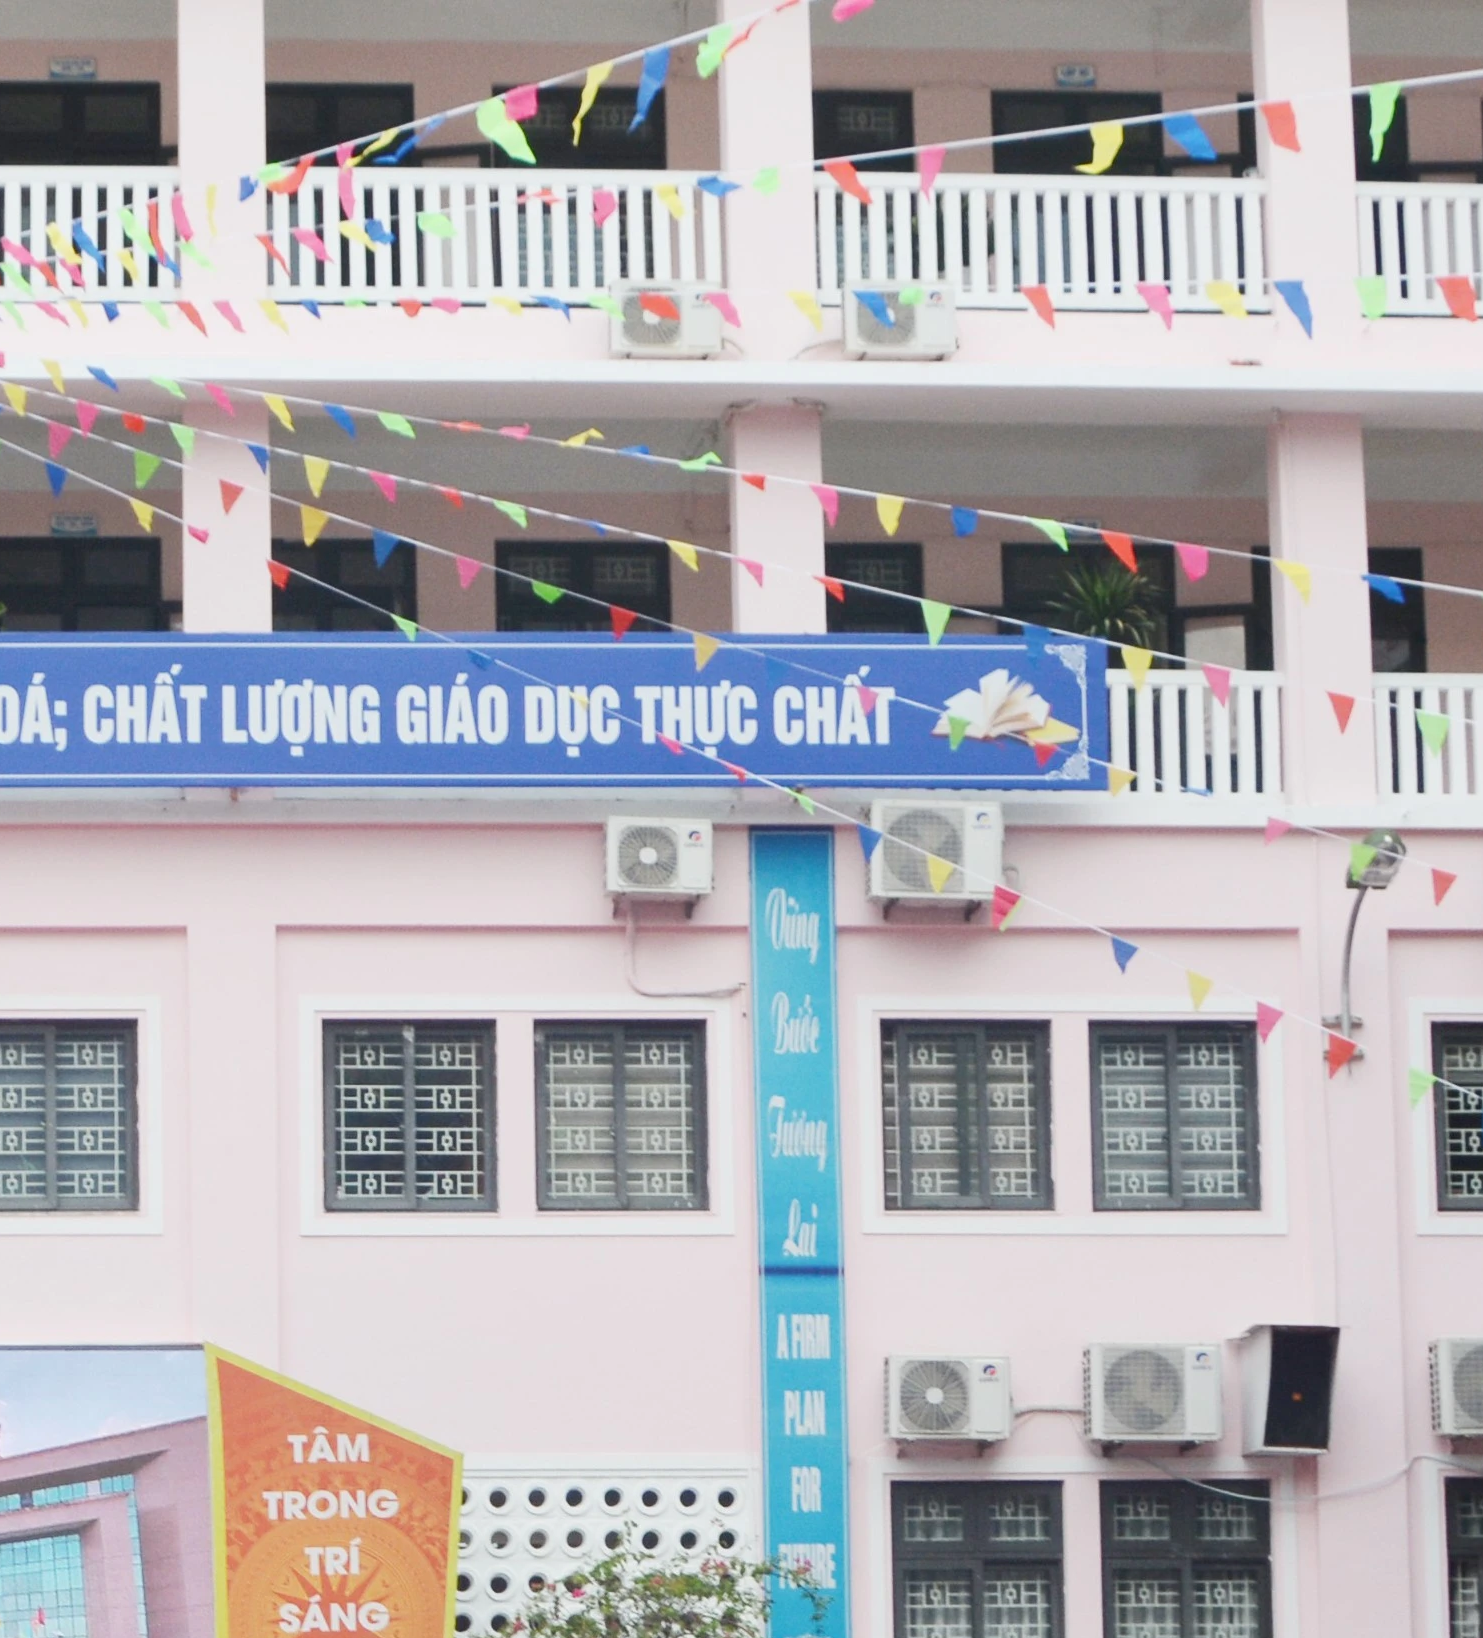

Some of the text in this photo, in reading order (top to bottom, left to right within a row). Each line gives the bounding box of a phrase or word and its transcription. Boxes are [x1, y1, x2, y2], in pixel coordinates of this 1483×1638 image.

[83, 664, 208, 744] CHẤT
[222, 679, 381, 757] LƯỢNG
[395, 673, 509, 744] GIÁO
[524, 684, 621, 757] DỤC
[635, 680, 758, 757] THỰC
[773, 665, 896, 745] CHẤT
[783, 1198, 817, 1257] Lai
[777, 1314, 831, 1359] A FIRM
[784, 1390, 826, 1436] PLAN
[287, 1426, 369, 1463] TÂM
[263, 1488, 400, 1520] TRONG
[791, 1466, 821, 1512] FOR
[305, 1537, 363, 1575] TRÍ
[279, 1595, 390, 1633] SÁNG
